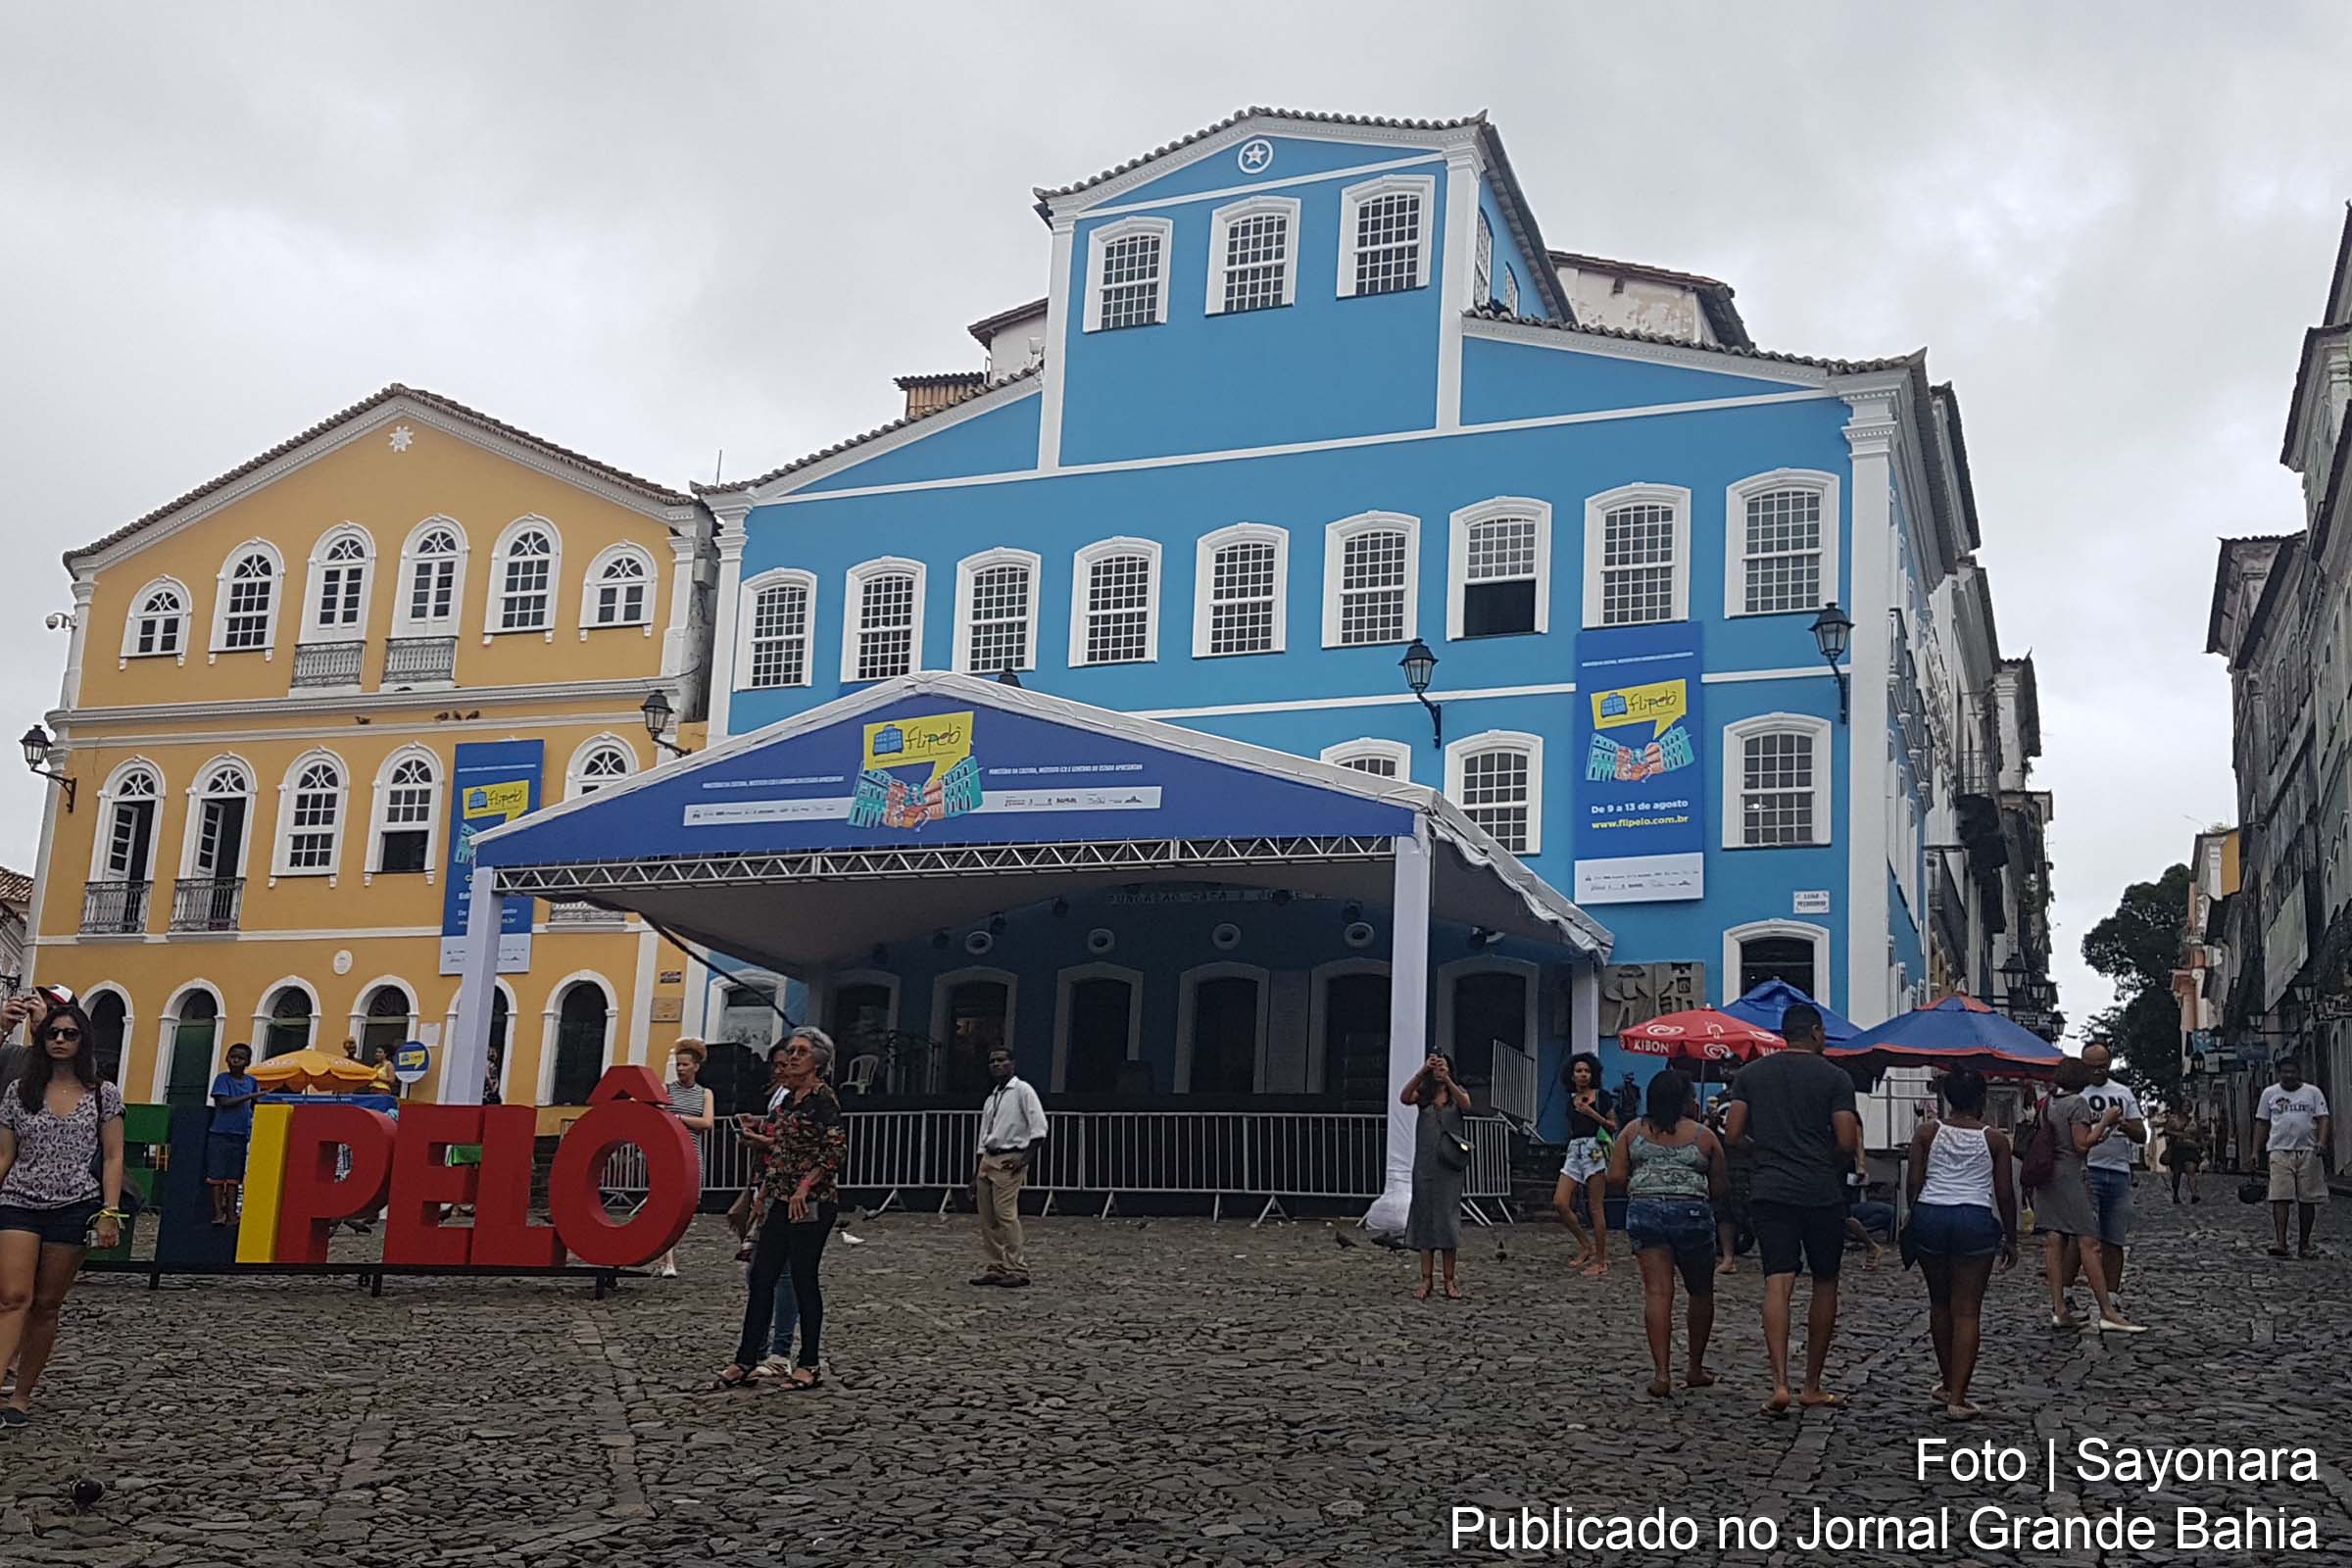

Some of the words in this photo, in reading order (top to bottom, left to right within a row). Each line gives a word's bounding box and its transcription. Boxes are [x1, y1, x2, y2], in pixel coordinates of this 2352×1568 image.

[1625, 803, 1636, 811] 13
[1638, 802, 1651, 810] de
[1653, 800, 1689, 810] agosto
[1592, 815, 1690, 828] www.flipelo.com.br
[1634, 1038, 1669, 1053] KIBON
